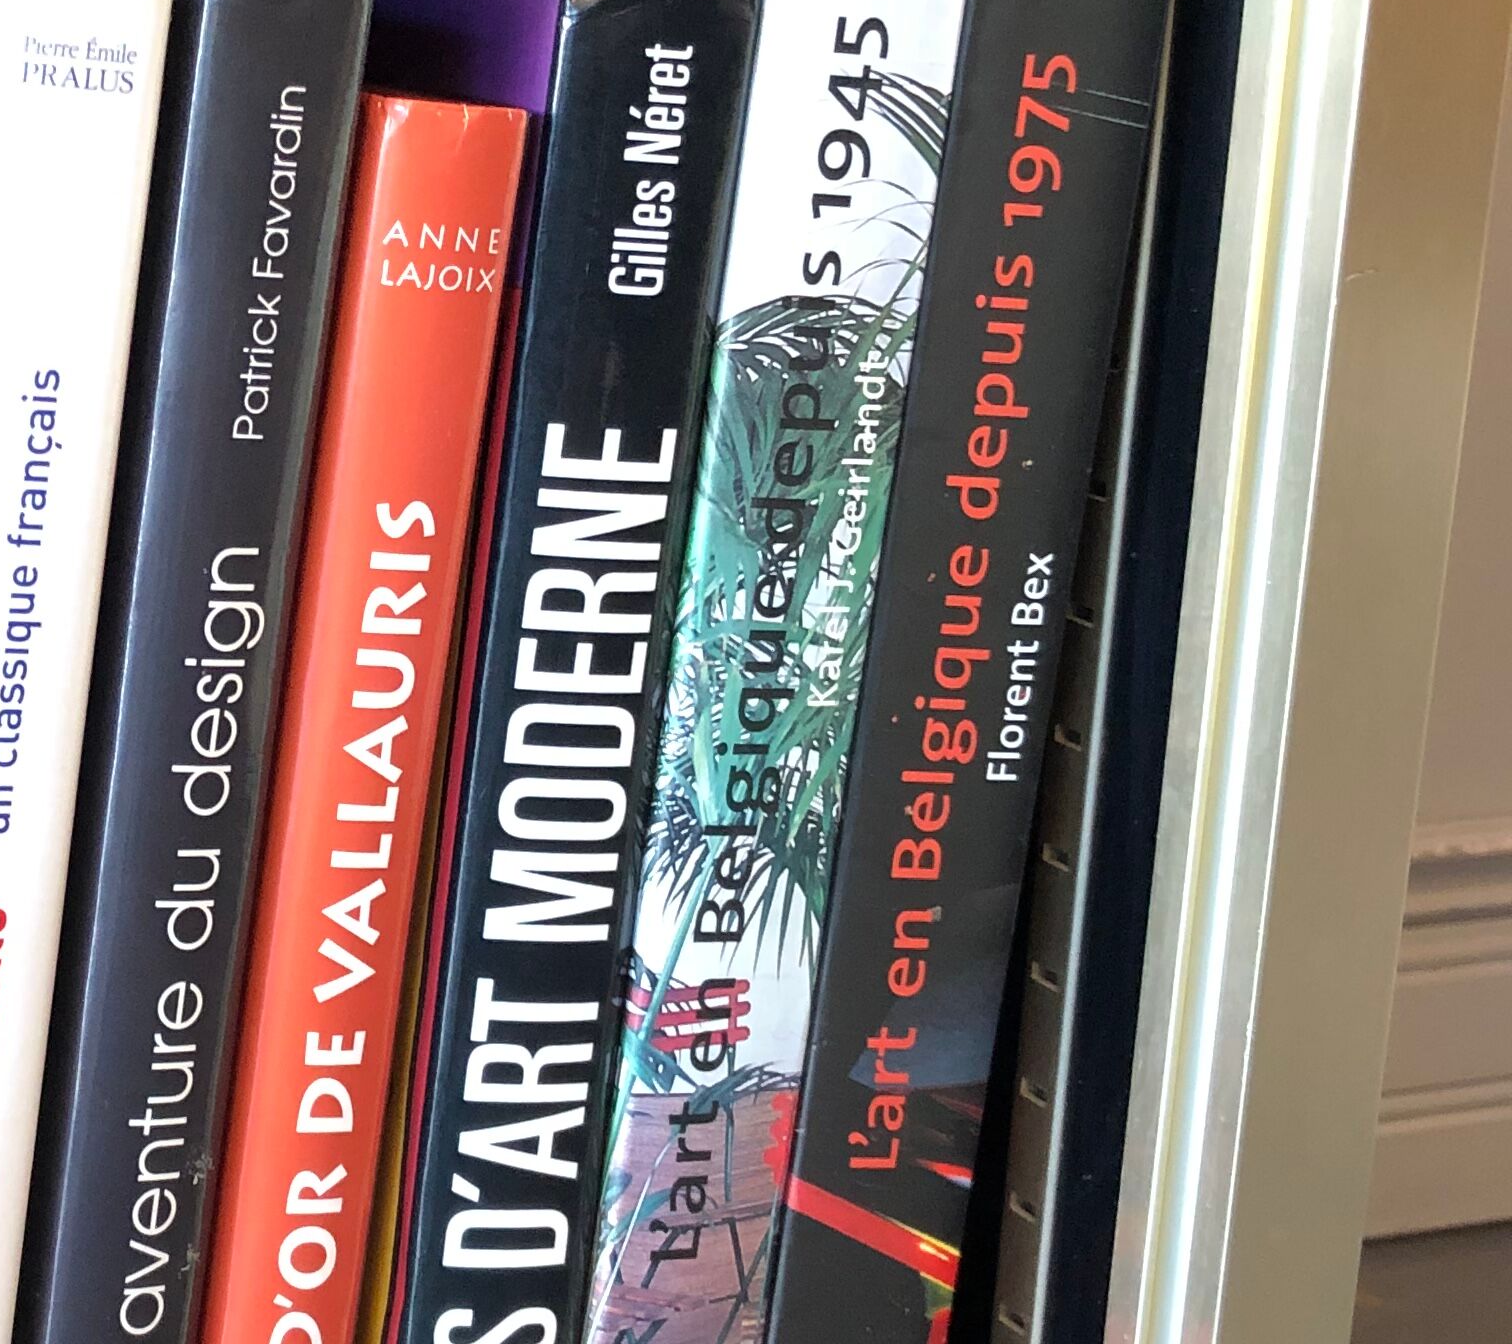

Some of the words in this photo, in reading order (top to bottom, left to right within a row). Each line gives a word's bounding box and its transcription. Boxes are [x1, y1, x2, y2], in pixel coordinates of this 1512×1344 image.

[23, 61, 134, 94] PRALUS
[24, 36, 79, 59] Pierre
[86, 37, 137, 64] Émile
[624, 42, 694, 165] Néret
[812, 16, 889, 220] 1945
[252, 84, 306, 279] Favardin
[1001, 52, 1078, 228] 1975
[381, 259, 496, 292] LAJOIX
[382, 220, 501, 254] ANNE
[608, 178, 676, 297] Gilles
[232, 295, 282, 440] Patrick
[752, 250, 842, 544] depuis
[946, 253, 1035, 523] depuis
[8, 368, 62, 549] français
[1011, 552, 1055, 627] Bex
[172, 546, 265, 817] design
[313, 500, 436, 1004] VALLAURIS
[482, 422, 677, 944] MODERNE
[892, 542, 990, 880] Belgique
[985, 638, 1040, 783] Florent
[694, 572, 796, 944] Belgique
[155, 847, 222, 952] du
[888, 906, 930, 1000] en
[296, 1029, 366, 1134] DE
[689, 975, 735, 1075] en
[848, 1025, 916, 1171] L'art
[441, 977, 599, 1268] D'ART
[649, 1099, 722, 1262] L'art
